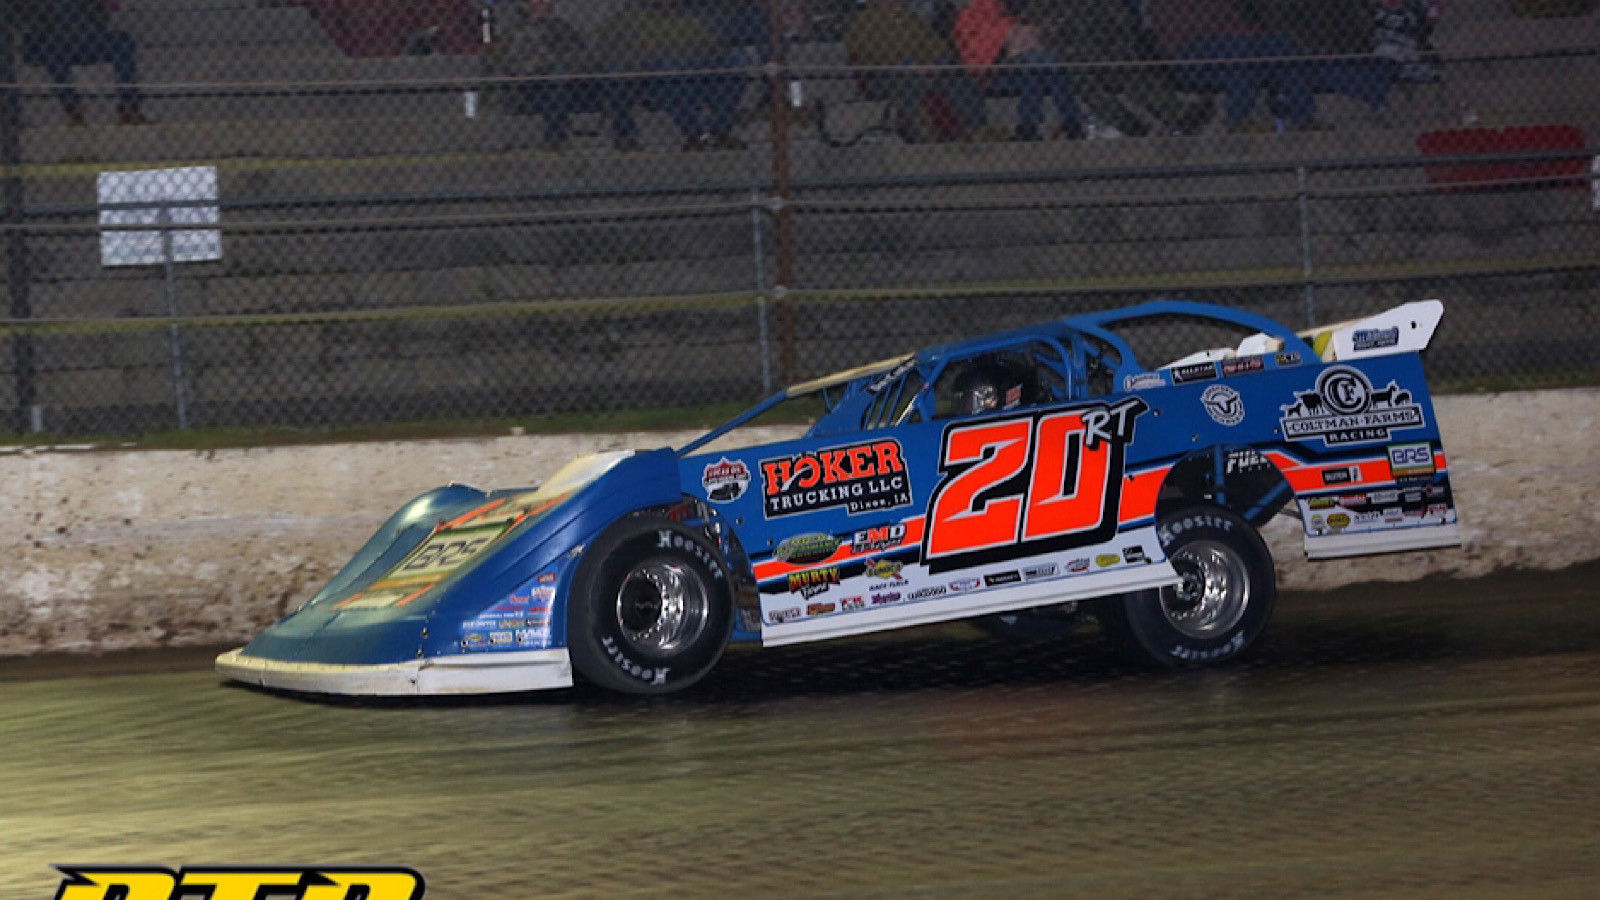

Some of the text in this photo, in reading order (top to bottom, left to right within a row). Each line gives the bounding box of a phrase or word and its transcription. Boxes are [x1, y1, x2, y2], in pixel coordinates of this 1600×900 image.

[1329, 428, 1386, 442] RACING
[763, 441, 903, 496] HOKER
[926, 410, 1111, 558] 20
[1081, 399, 1142, 446] RT
[769, 477, 902, 511] TRUCKING LLC
